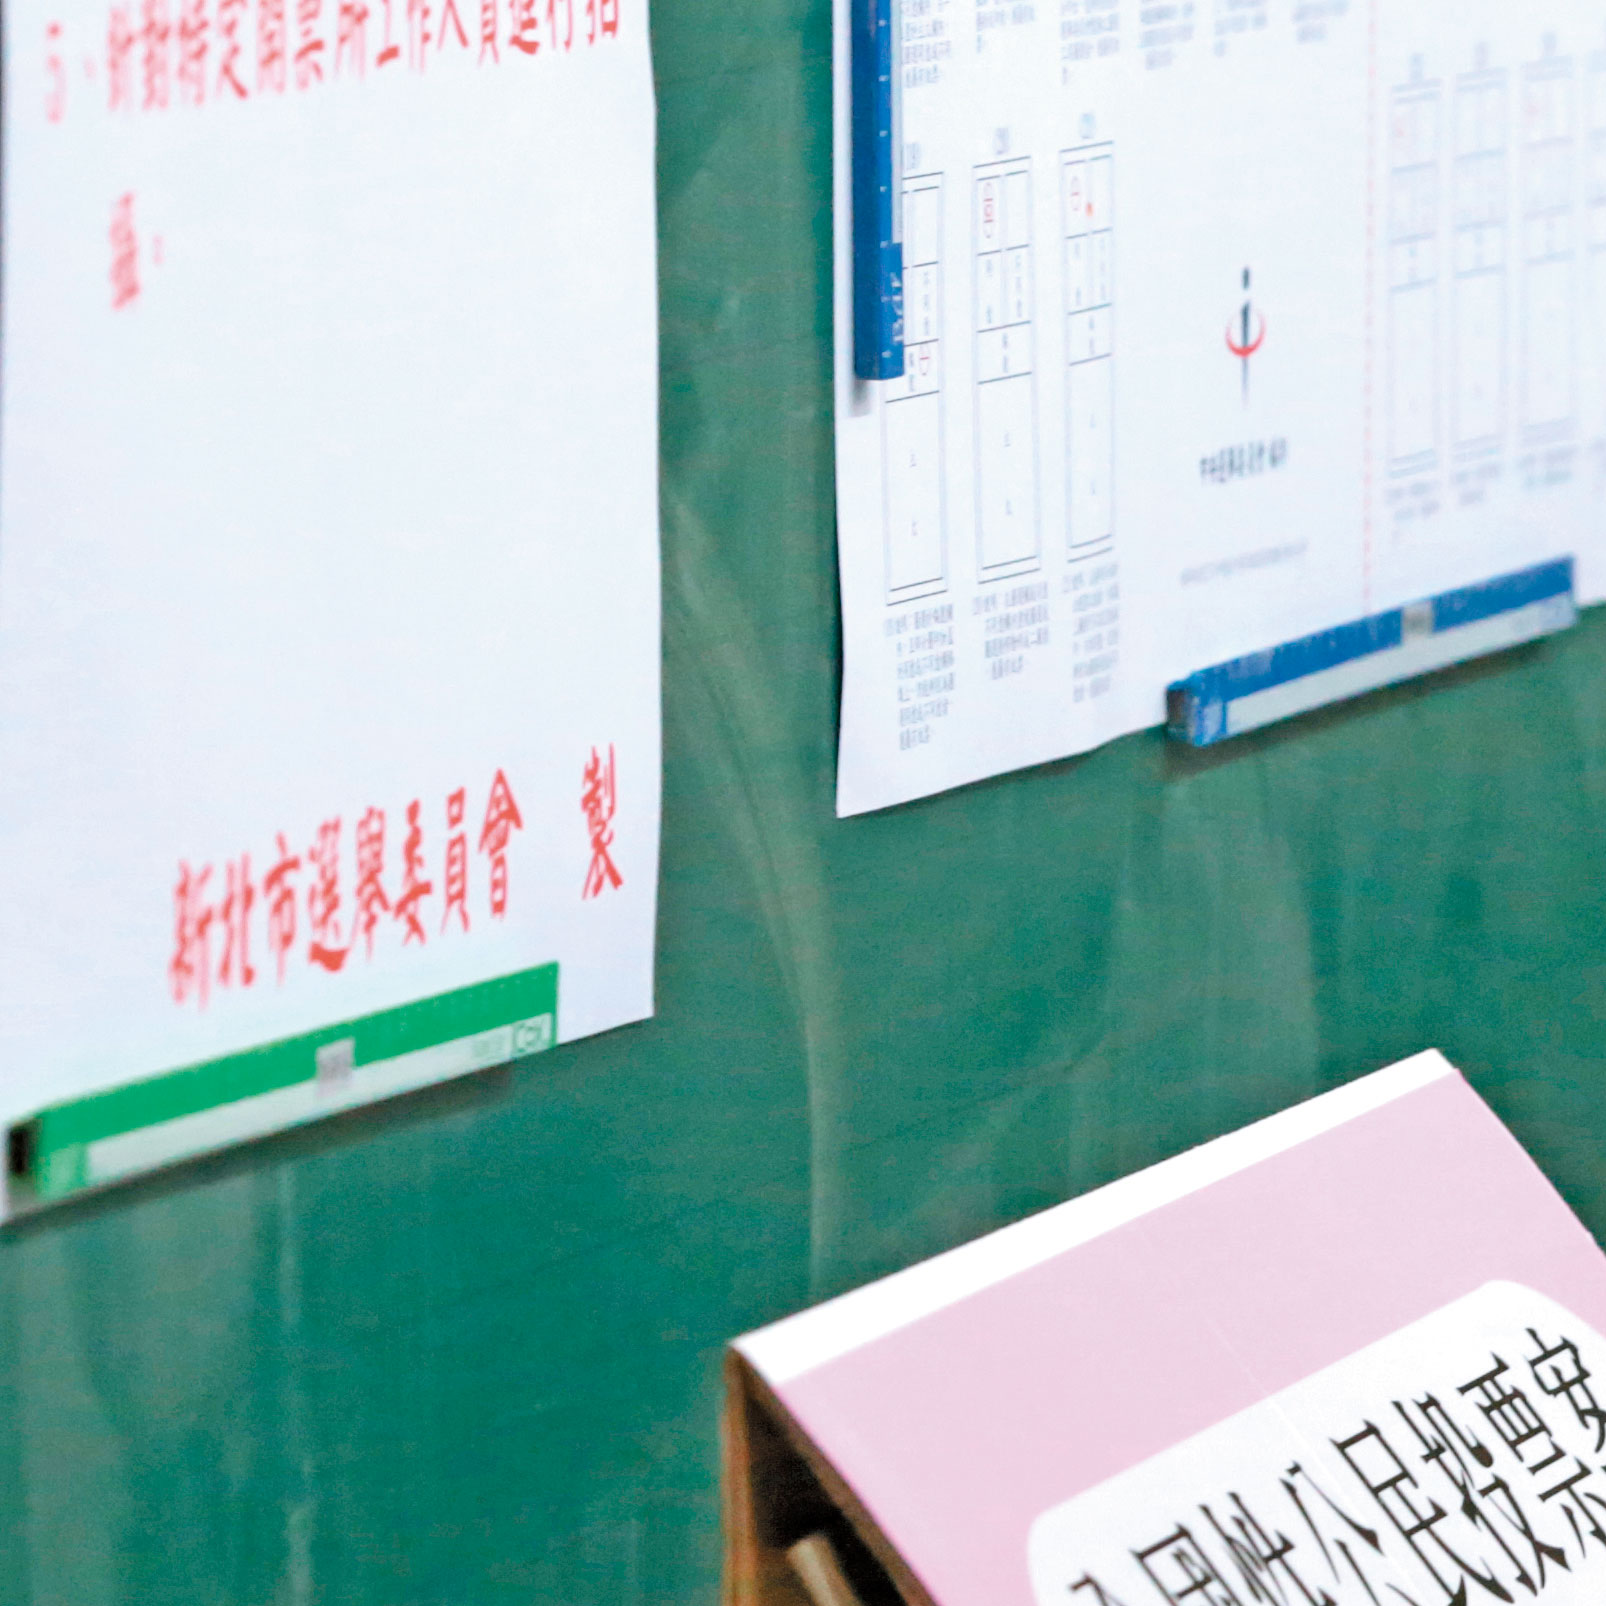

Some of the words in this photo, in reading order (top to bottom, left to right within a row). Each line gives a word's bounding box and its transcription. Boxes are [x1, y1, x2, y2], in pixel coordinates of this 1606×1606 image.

[167, 766, 523, 1014] 新北市選舉委員會
[580, 742, 624, 901] 製
